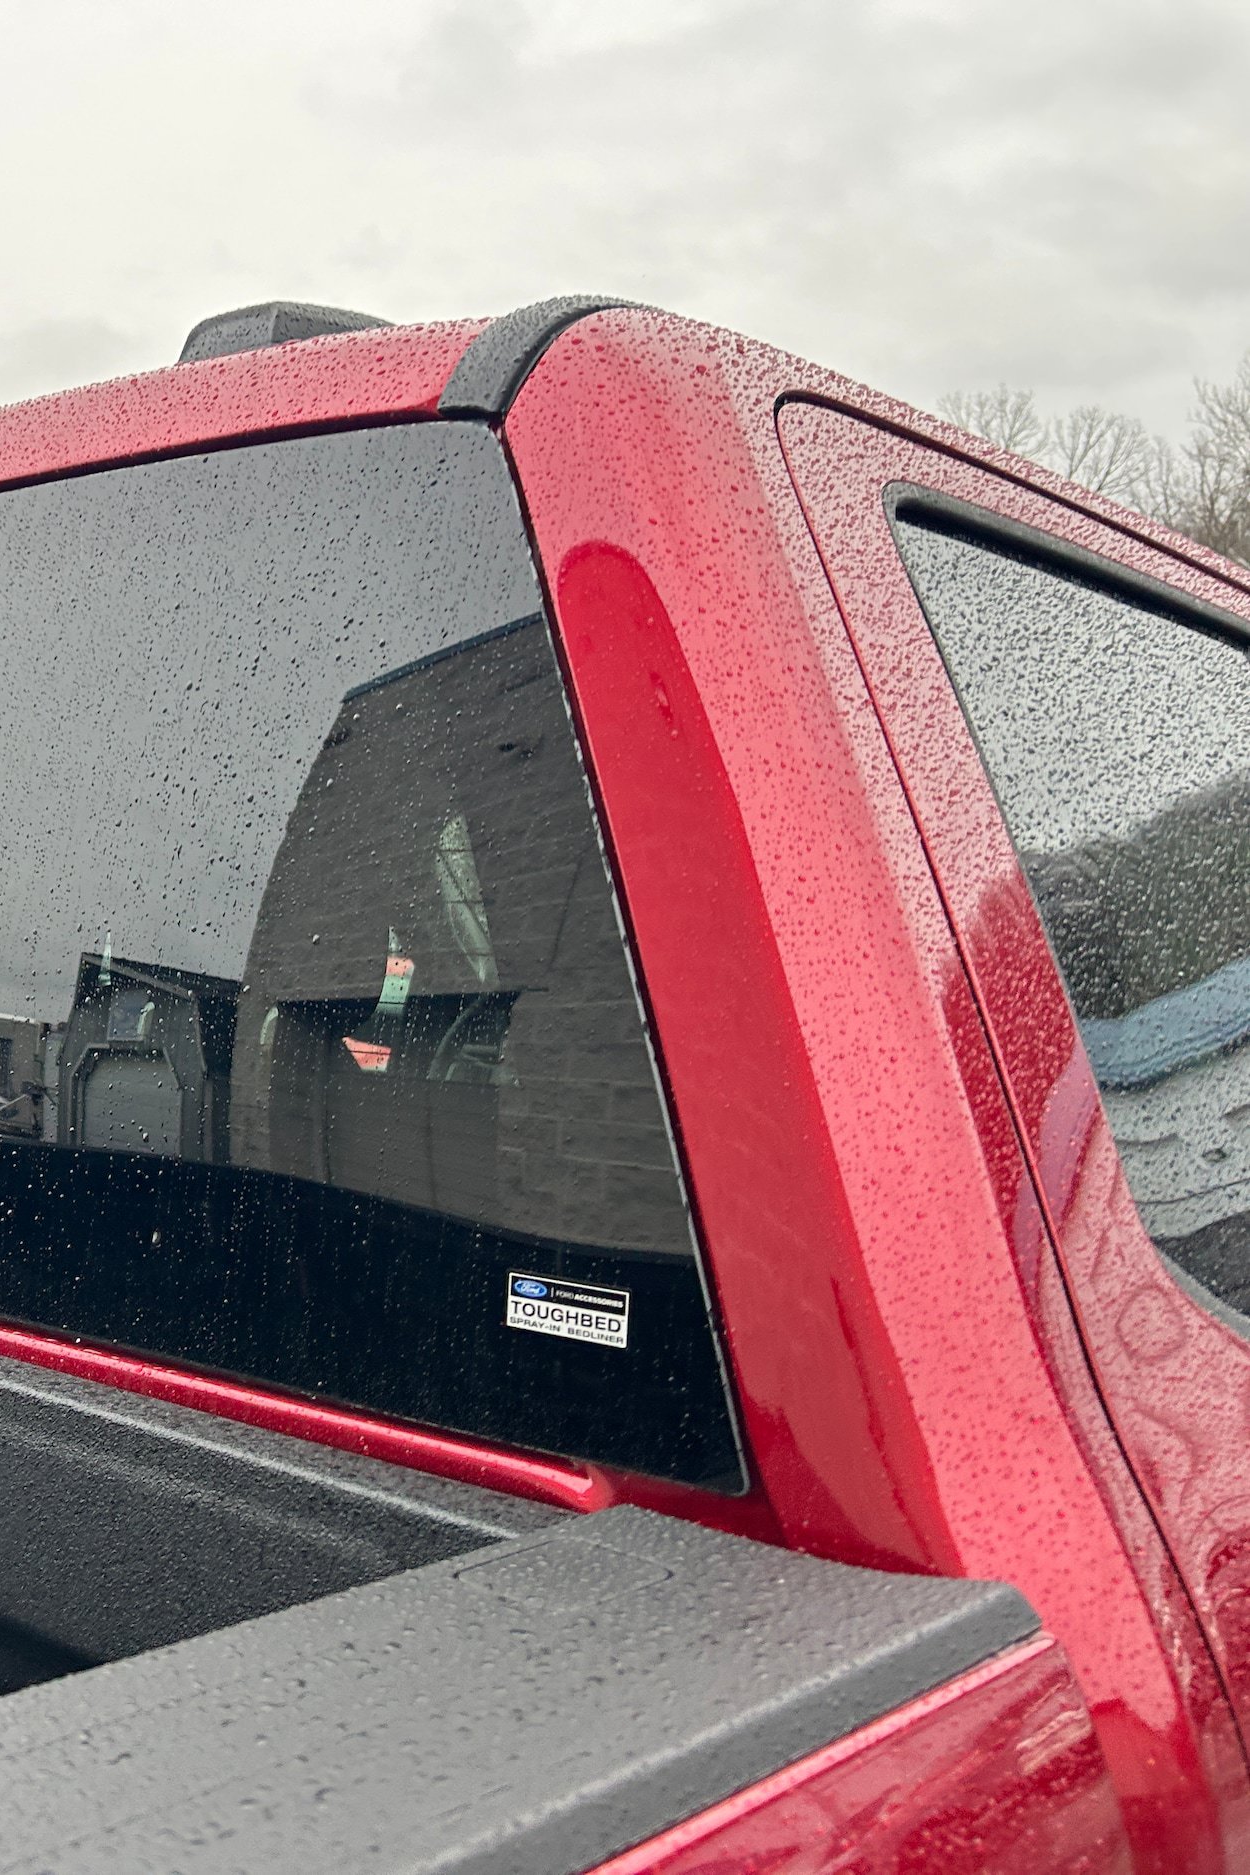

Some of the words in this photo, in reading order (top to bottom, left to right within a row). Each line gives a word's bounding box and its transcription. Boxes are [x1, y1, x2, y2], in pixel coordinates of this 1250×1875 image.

[556, 1290, 574, 1300] FORD
[574, 1294, 624, 1308] ACCESSORIES
[509, 1316, 561, 1332] SPRAY-IN
[567, 1328, 624, 1345] BEDLINER
[510, 1300, 621, 1333] TOUGHBED
